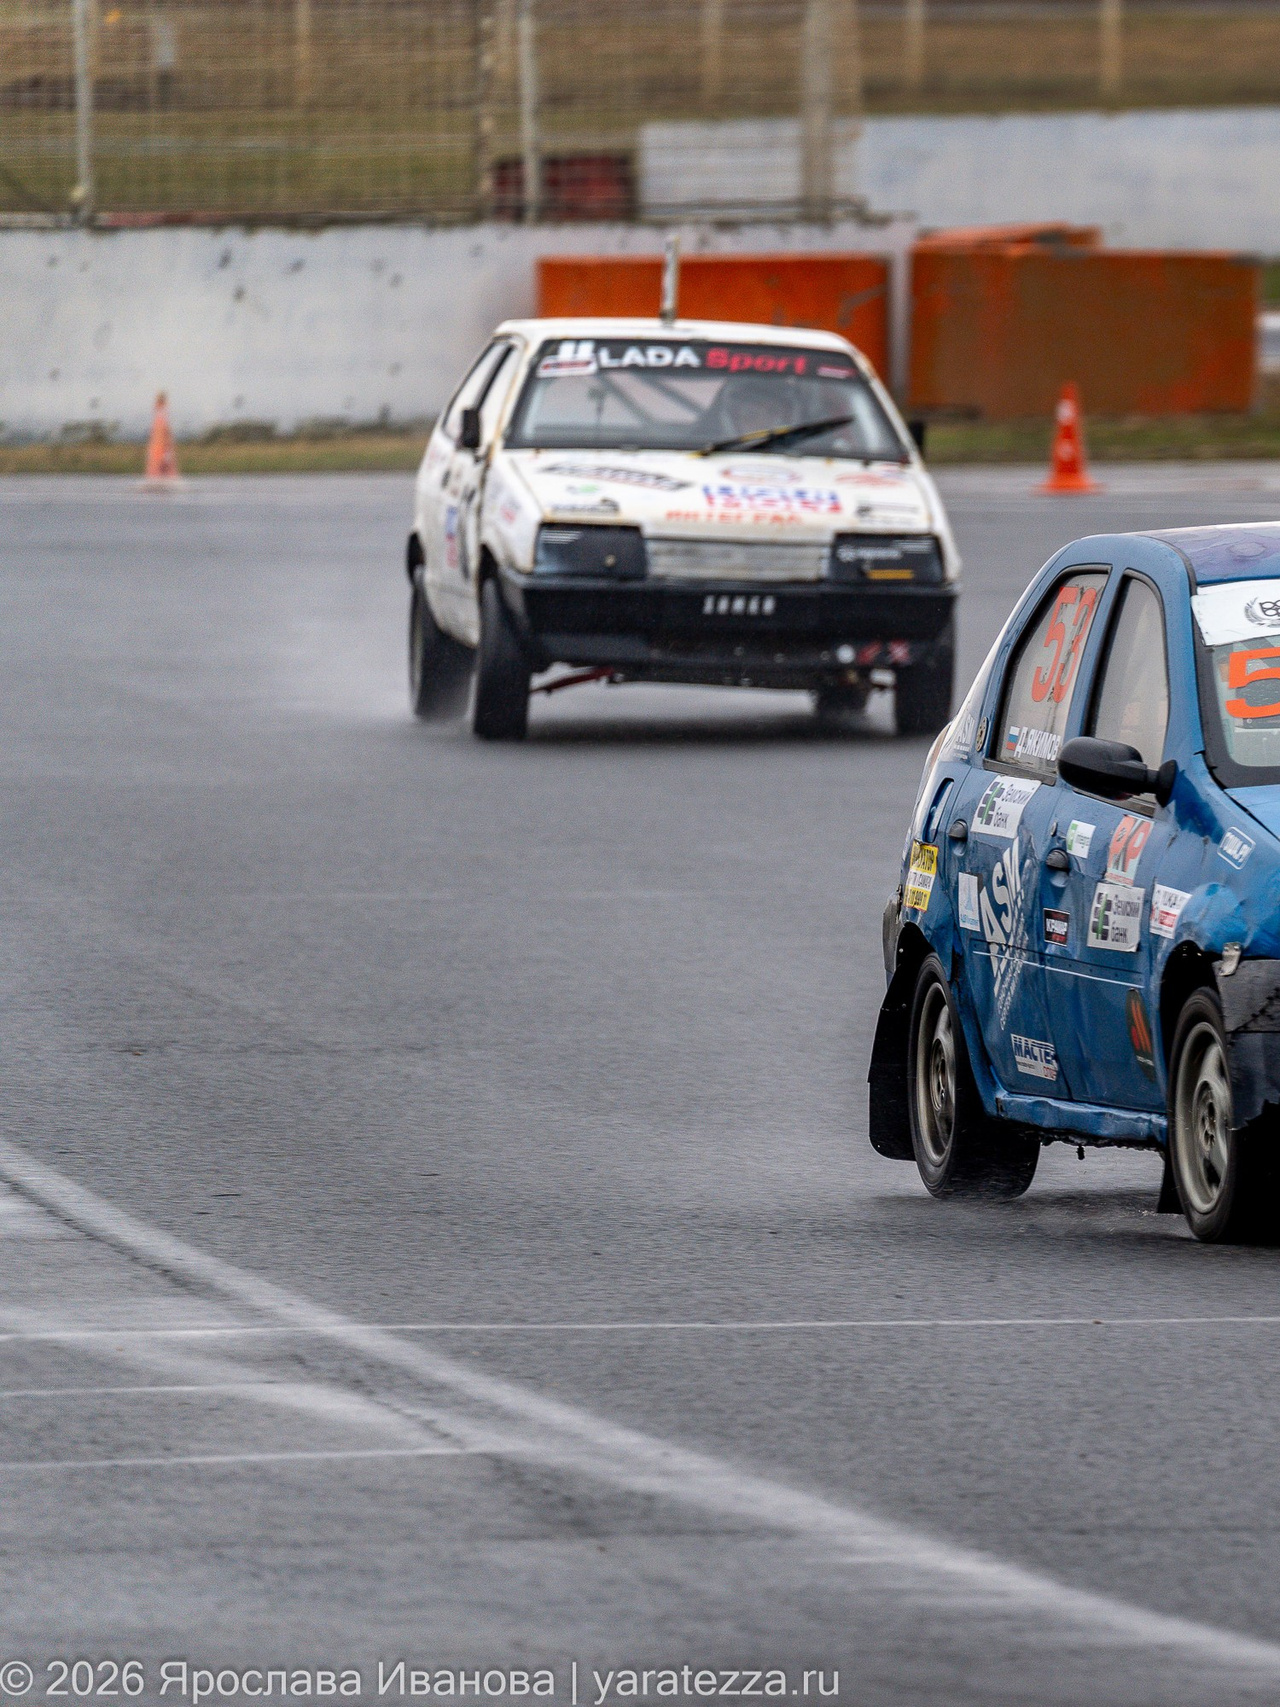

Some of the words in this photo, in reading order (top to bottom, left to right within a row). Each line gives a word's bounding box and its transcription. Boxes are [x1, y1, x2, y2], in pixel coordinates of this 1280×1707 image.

[600, 346, 699, 368] LADA
[705, 347, 808, 374] Sport
[1031, 586, 1097, 703] 53
